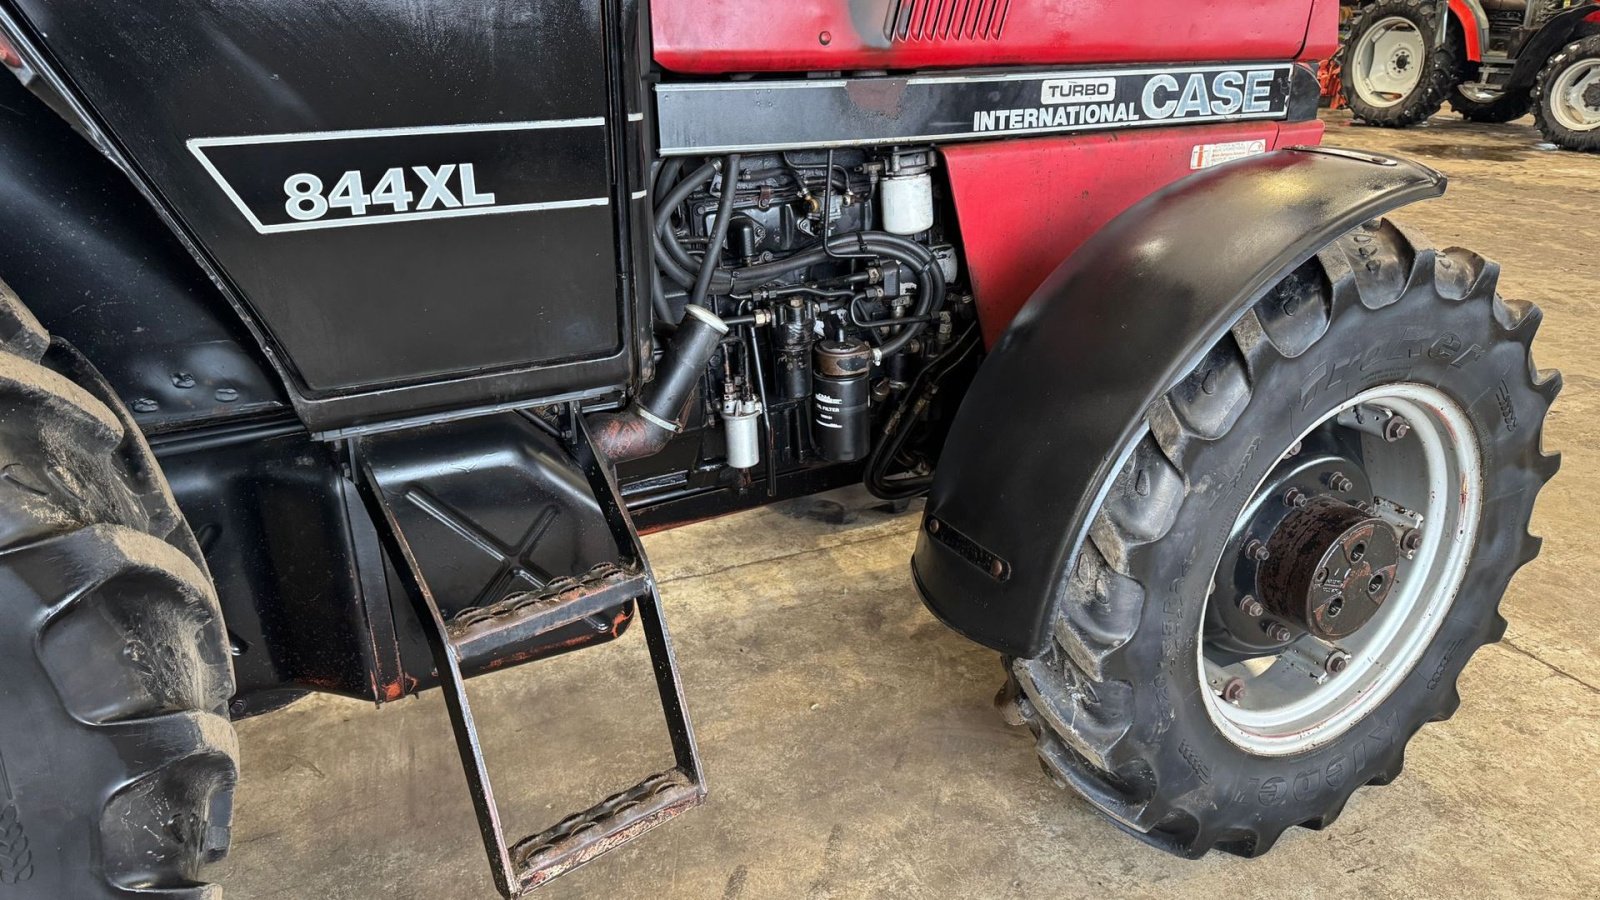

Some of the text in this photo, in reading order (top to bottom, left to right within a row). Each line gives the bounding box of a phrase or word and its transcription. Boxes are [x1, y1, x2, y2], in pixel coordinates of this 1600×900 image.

[973, 70, 1275, 131] INTERNATIONAL CASE
[1048, 83, 1109, 98] TURBO
[283, 163, 495, 221] 844XL
